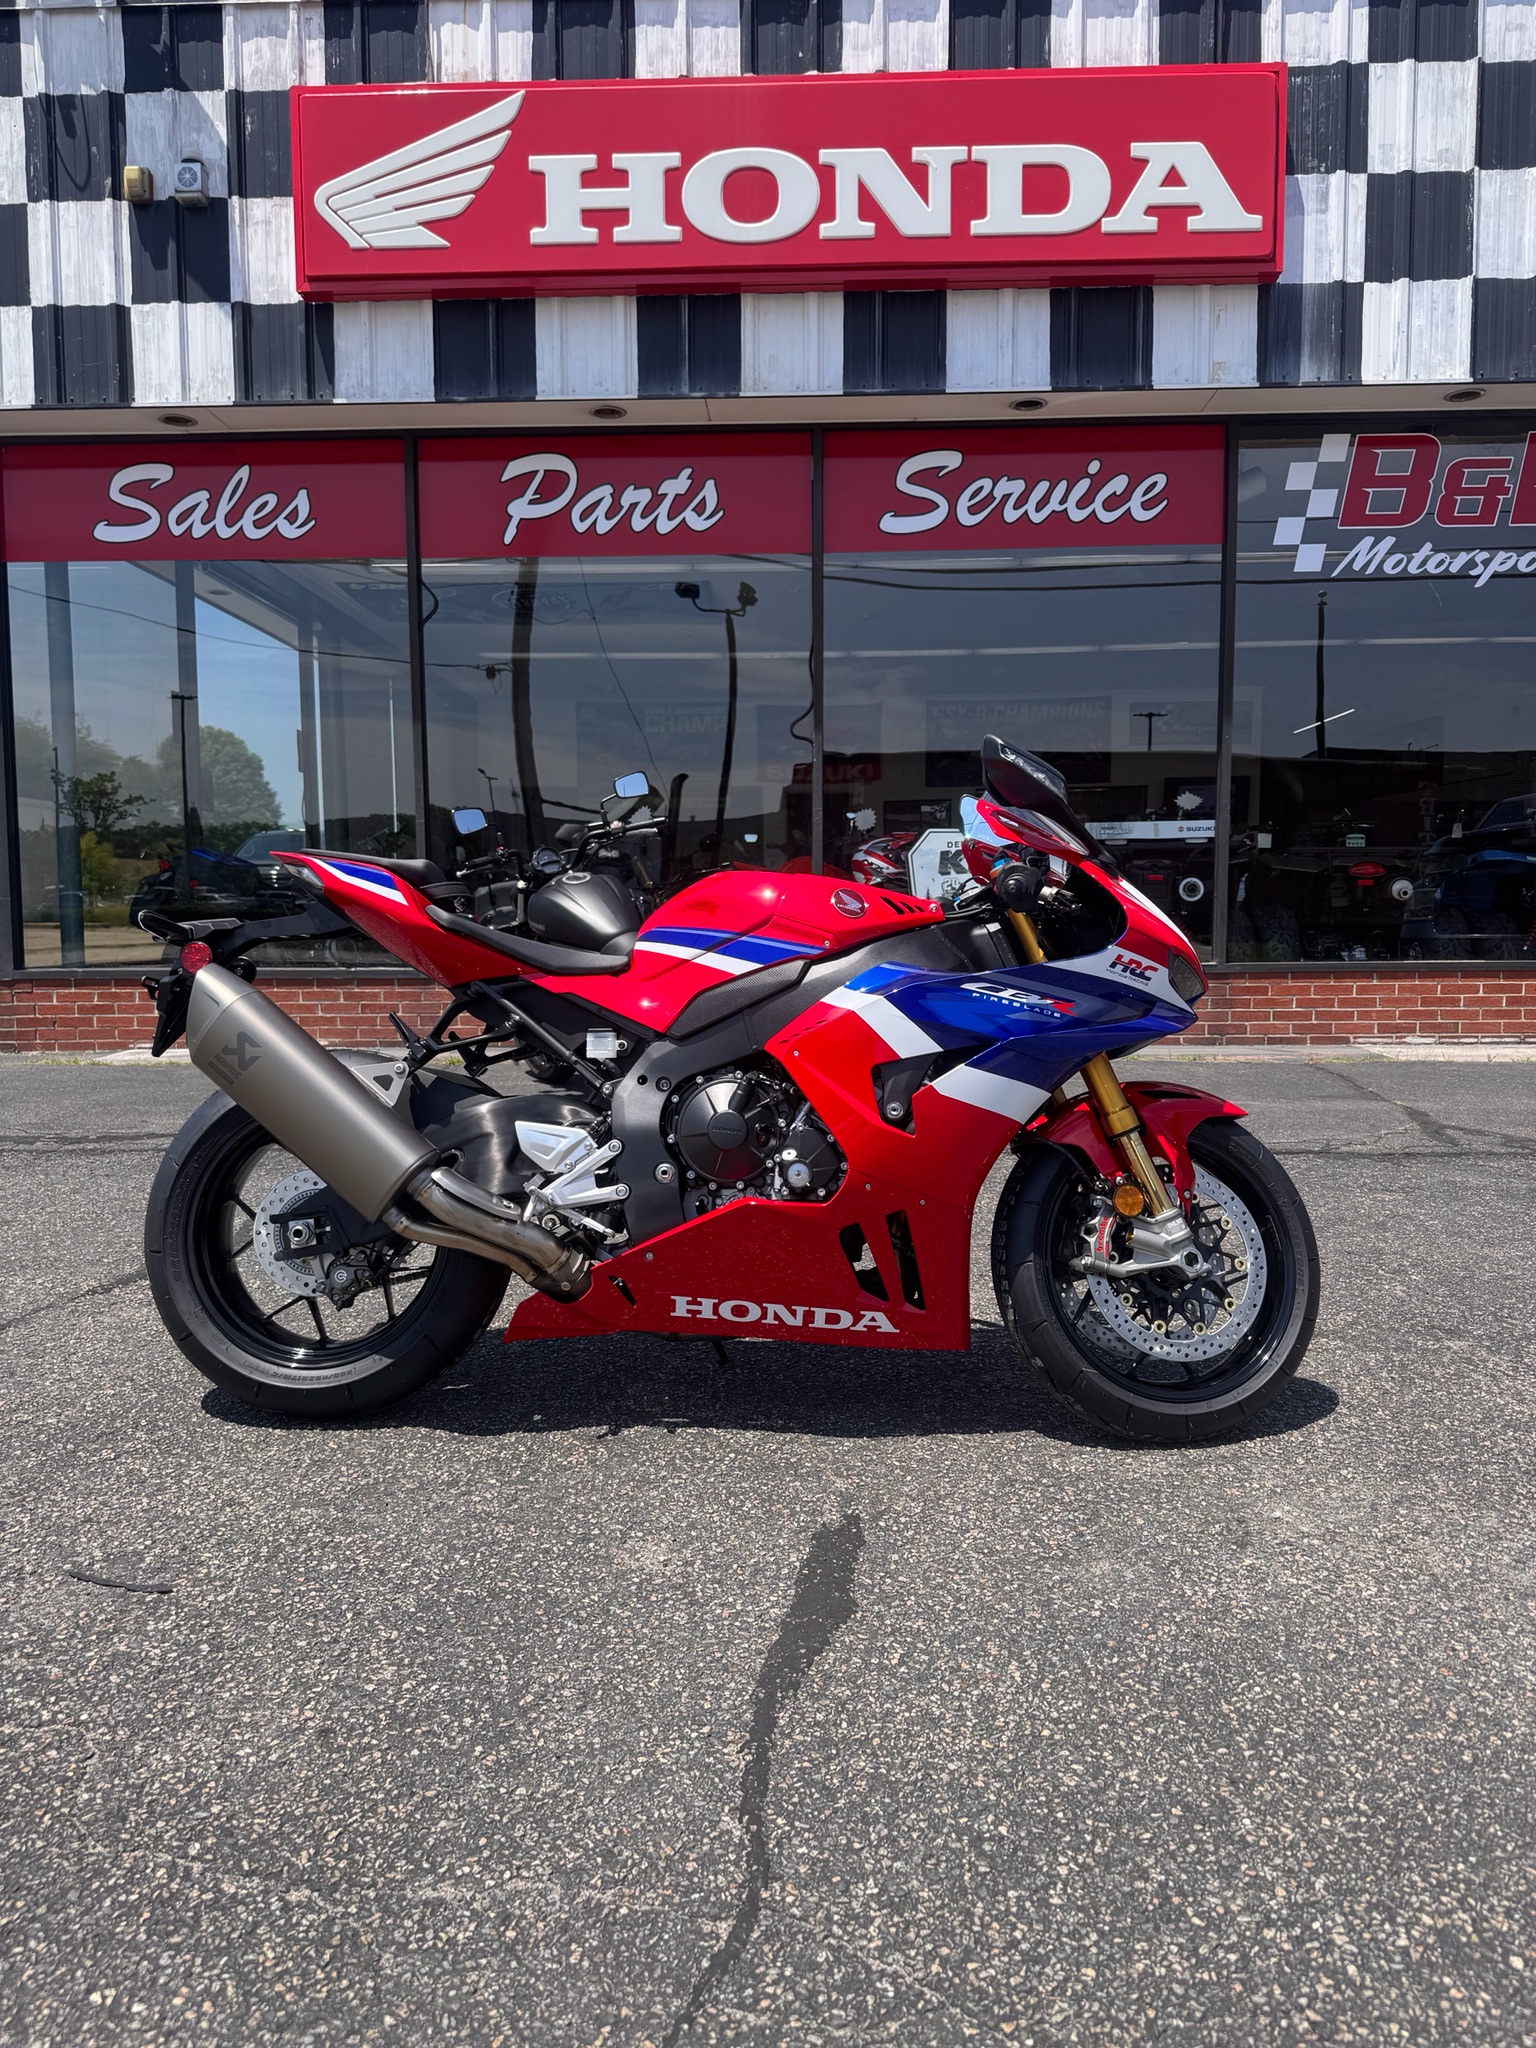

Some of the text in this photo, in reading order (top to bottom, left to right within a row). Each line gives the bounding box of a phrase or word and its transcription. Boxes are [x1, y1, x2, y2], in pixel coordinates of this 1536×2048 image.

[529, 142, 1263, 245] HONDA
[92, 461, 317, 543] Sales
[499, 452, 725, 546] Parts
[878, 449, 1169, 535] Service
[1337, 431, 1536, 529] B&
[1331, 535, 1536, 588] Motorspo
[993, 701, 1106, 723] CHAMPIONS
[1108, 953, 1159, 982] HRC
[971, 992, 1062, 1018] FIREBLADE
[1095, 1216, 1109, 1253] brembo
[670, 1295, 900, 1333] HONDA
